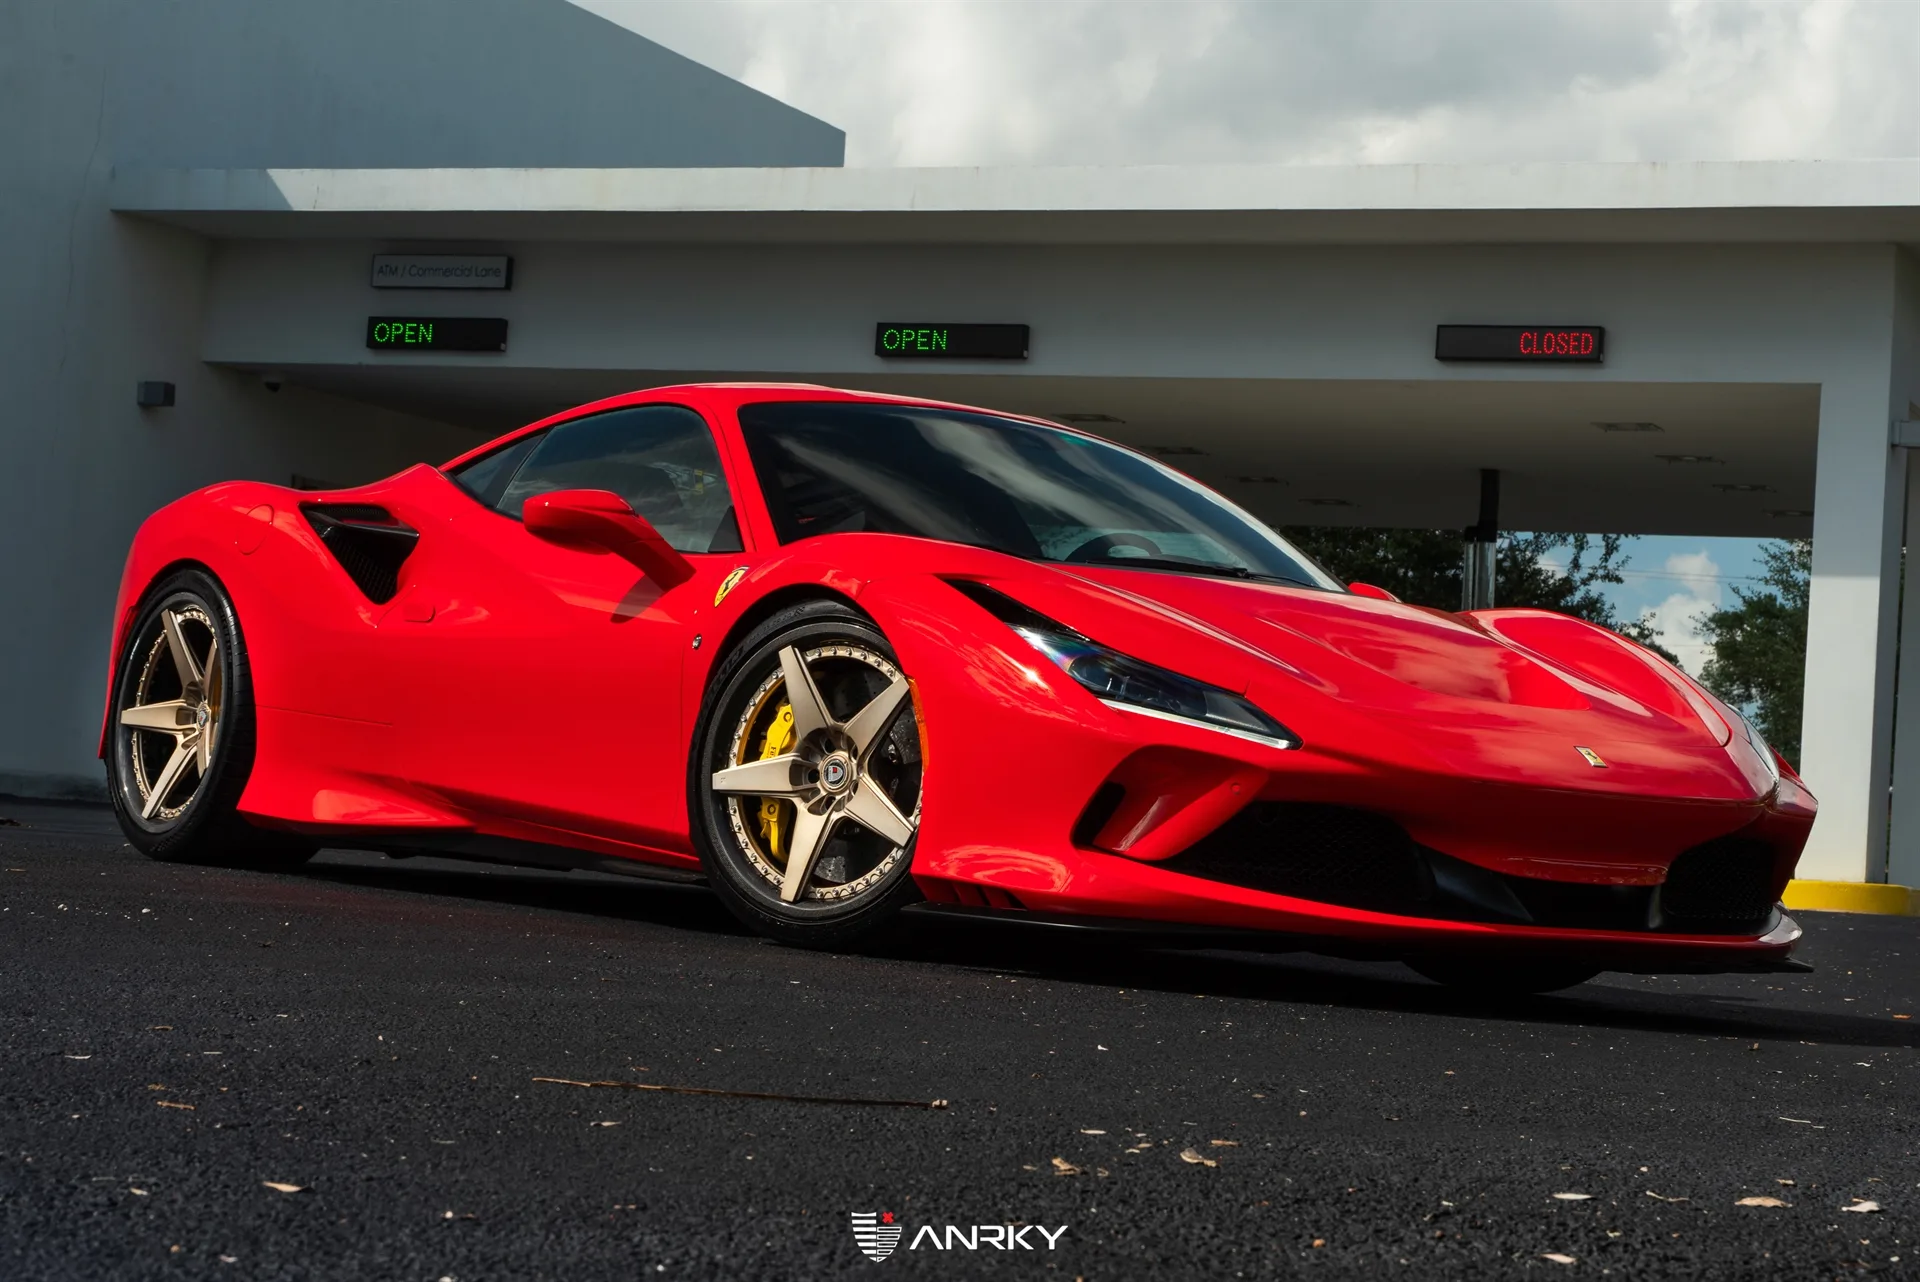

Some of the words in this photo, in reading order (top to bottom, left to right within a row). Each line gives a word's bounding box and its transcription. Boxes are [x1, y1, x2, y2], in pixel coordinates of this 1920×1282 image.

[377, 264, 398, 277] ATM
[408, 264, 473, 278] Commercial
[474, 265, 501, 278] Lane
[374, 322, 433, 343] OPEN
[883, 329, 948, 350] OPEN
[1519, 331, 1594, 355] CLOSED
